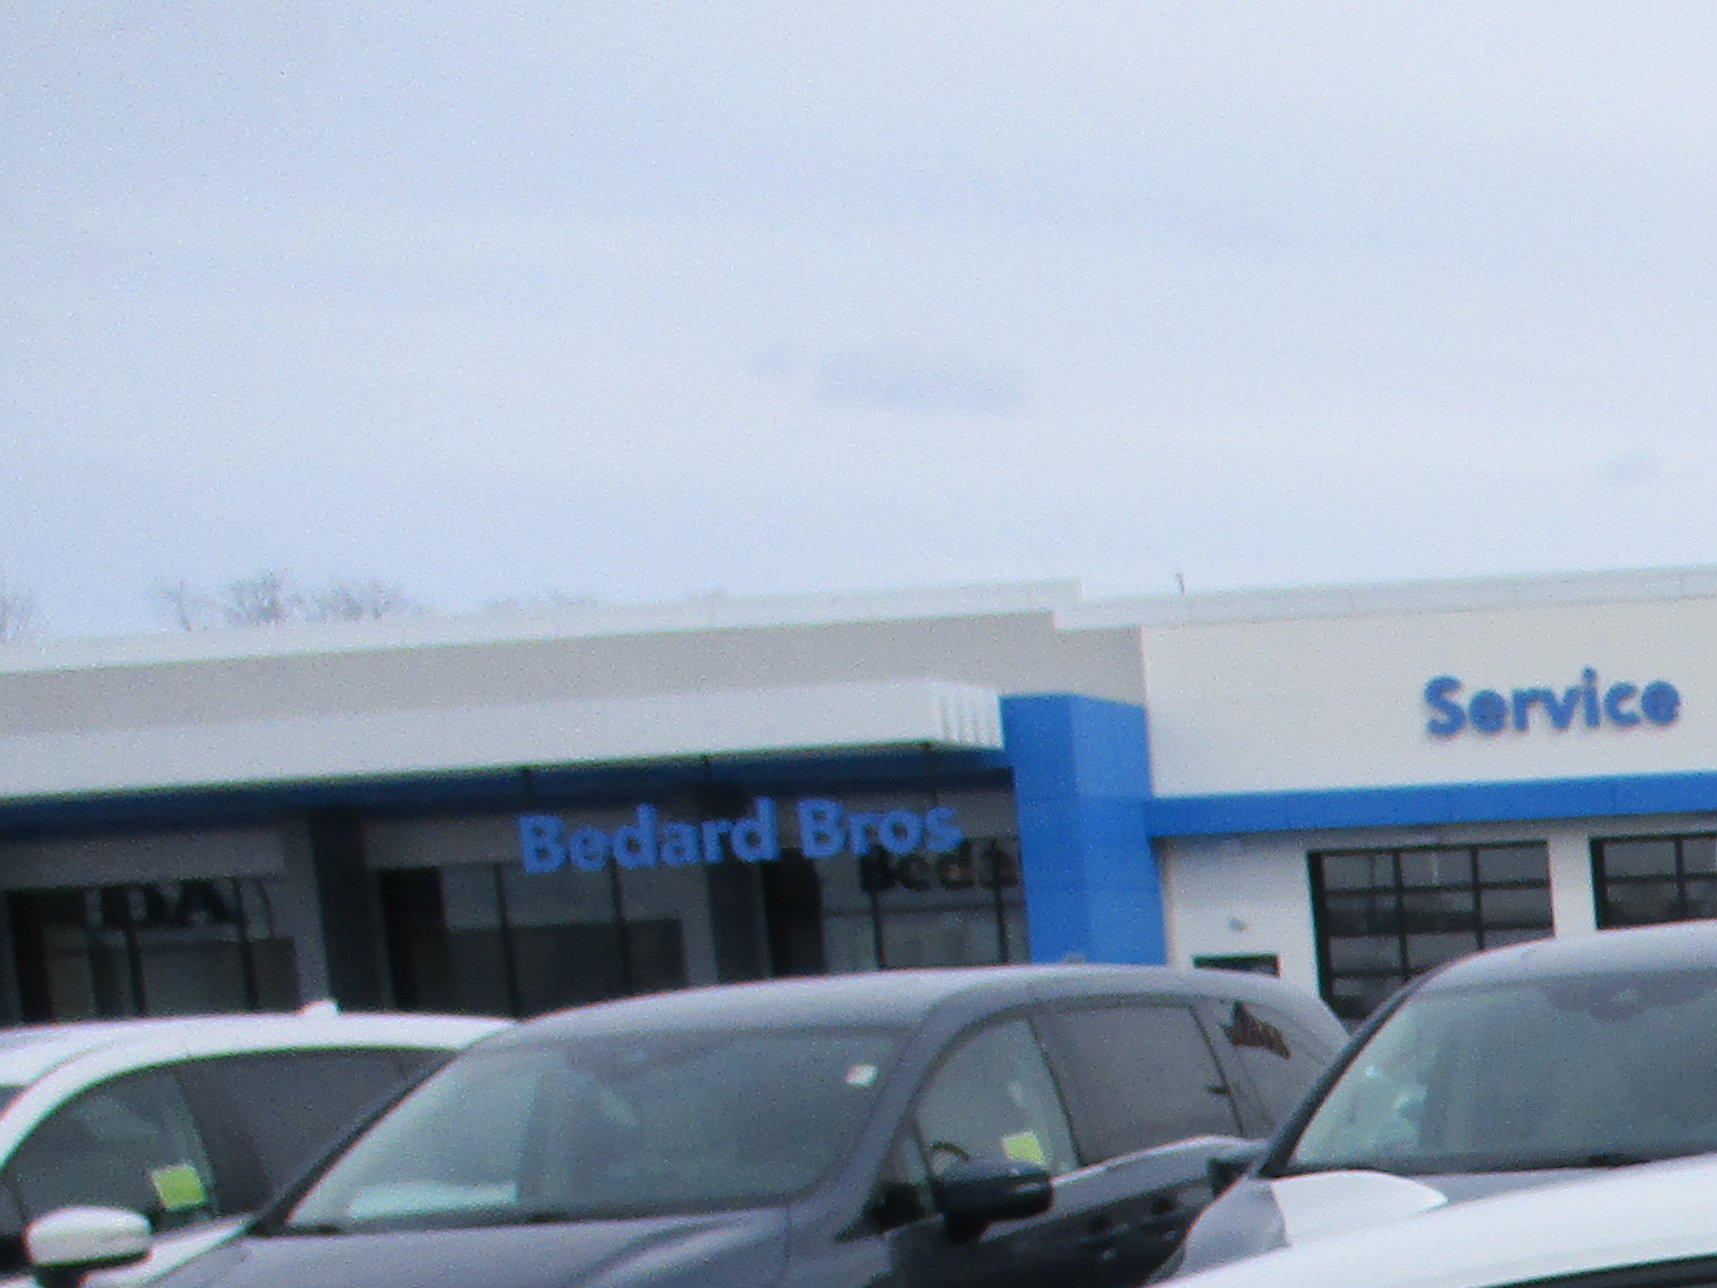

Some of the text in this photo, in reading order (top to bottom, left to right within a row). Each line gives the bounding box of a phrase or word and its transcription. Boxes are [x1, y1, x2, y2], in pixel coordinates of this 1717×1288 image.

[1423, 665, 1681, 736] Service
[518, 797, 961, 874] Bedard Bros
